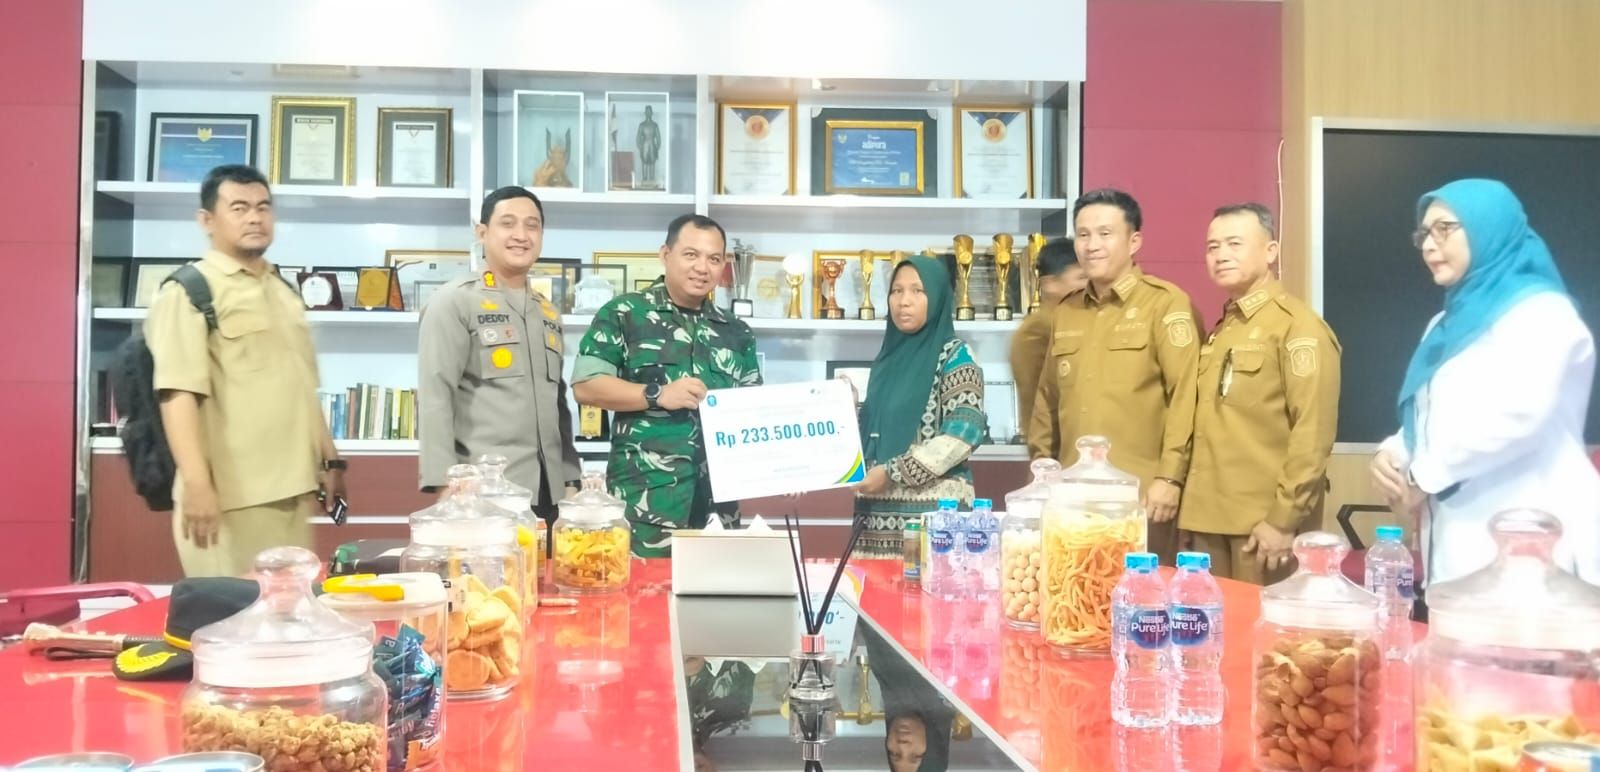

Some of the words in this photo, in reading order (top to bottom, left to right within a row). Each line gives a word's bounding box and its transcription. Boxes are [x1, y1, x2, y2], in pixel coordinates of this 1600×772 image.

[477, 314, 510, 325] DEDDY
[715, 431, 736, 448] Rp
[741, 420, 845, 444] 233.500.000,-
[1131, 622, 1156, 633] Pure
[1170, 621, 1188, 631] ure
[1189, 620, 1208, 635] Life
